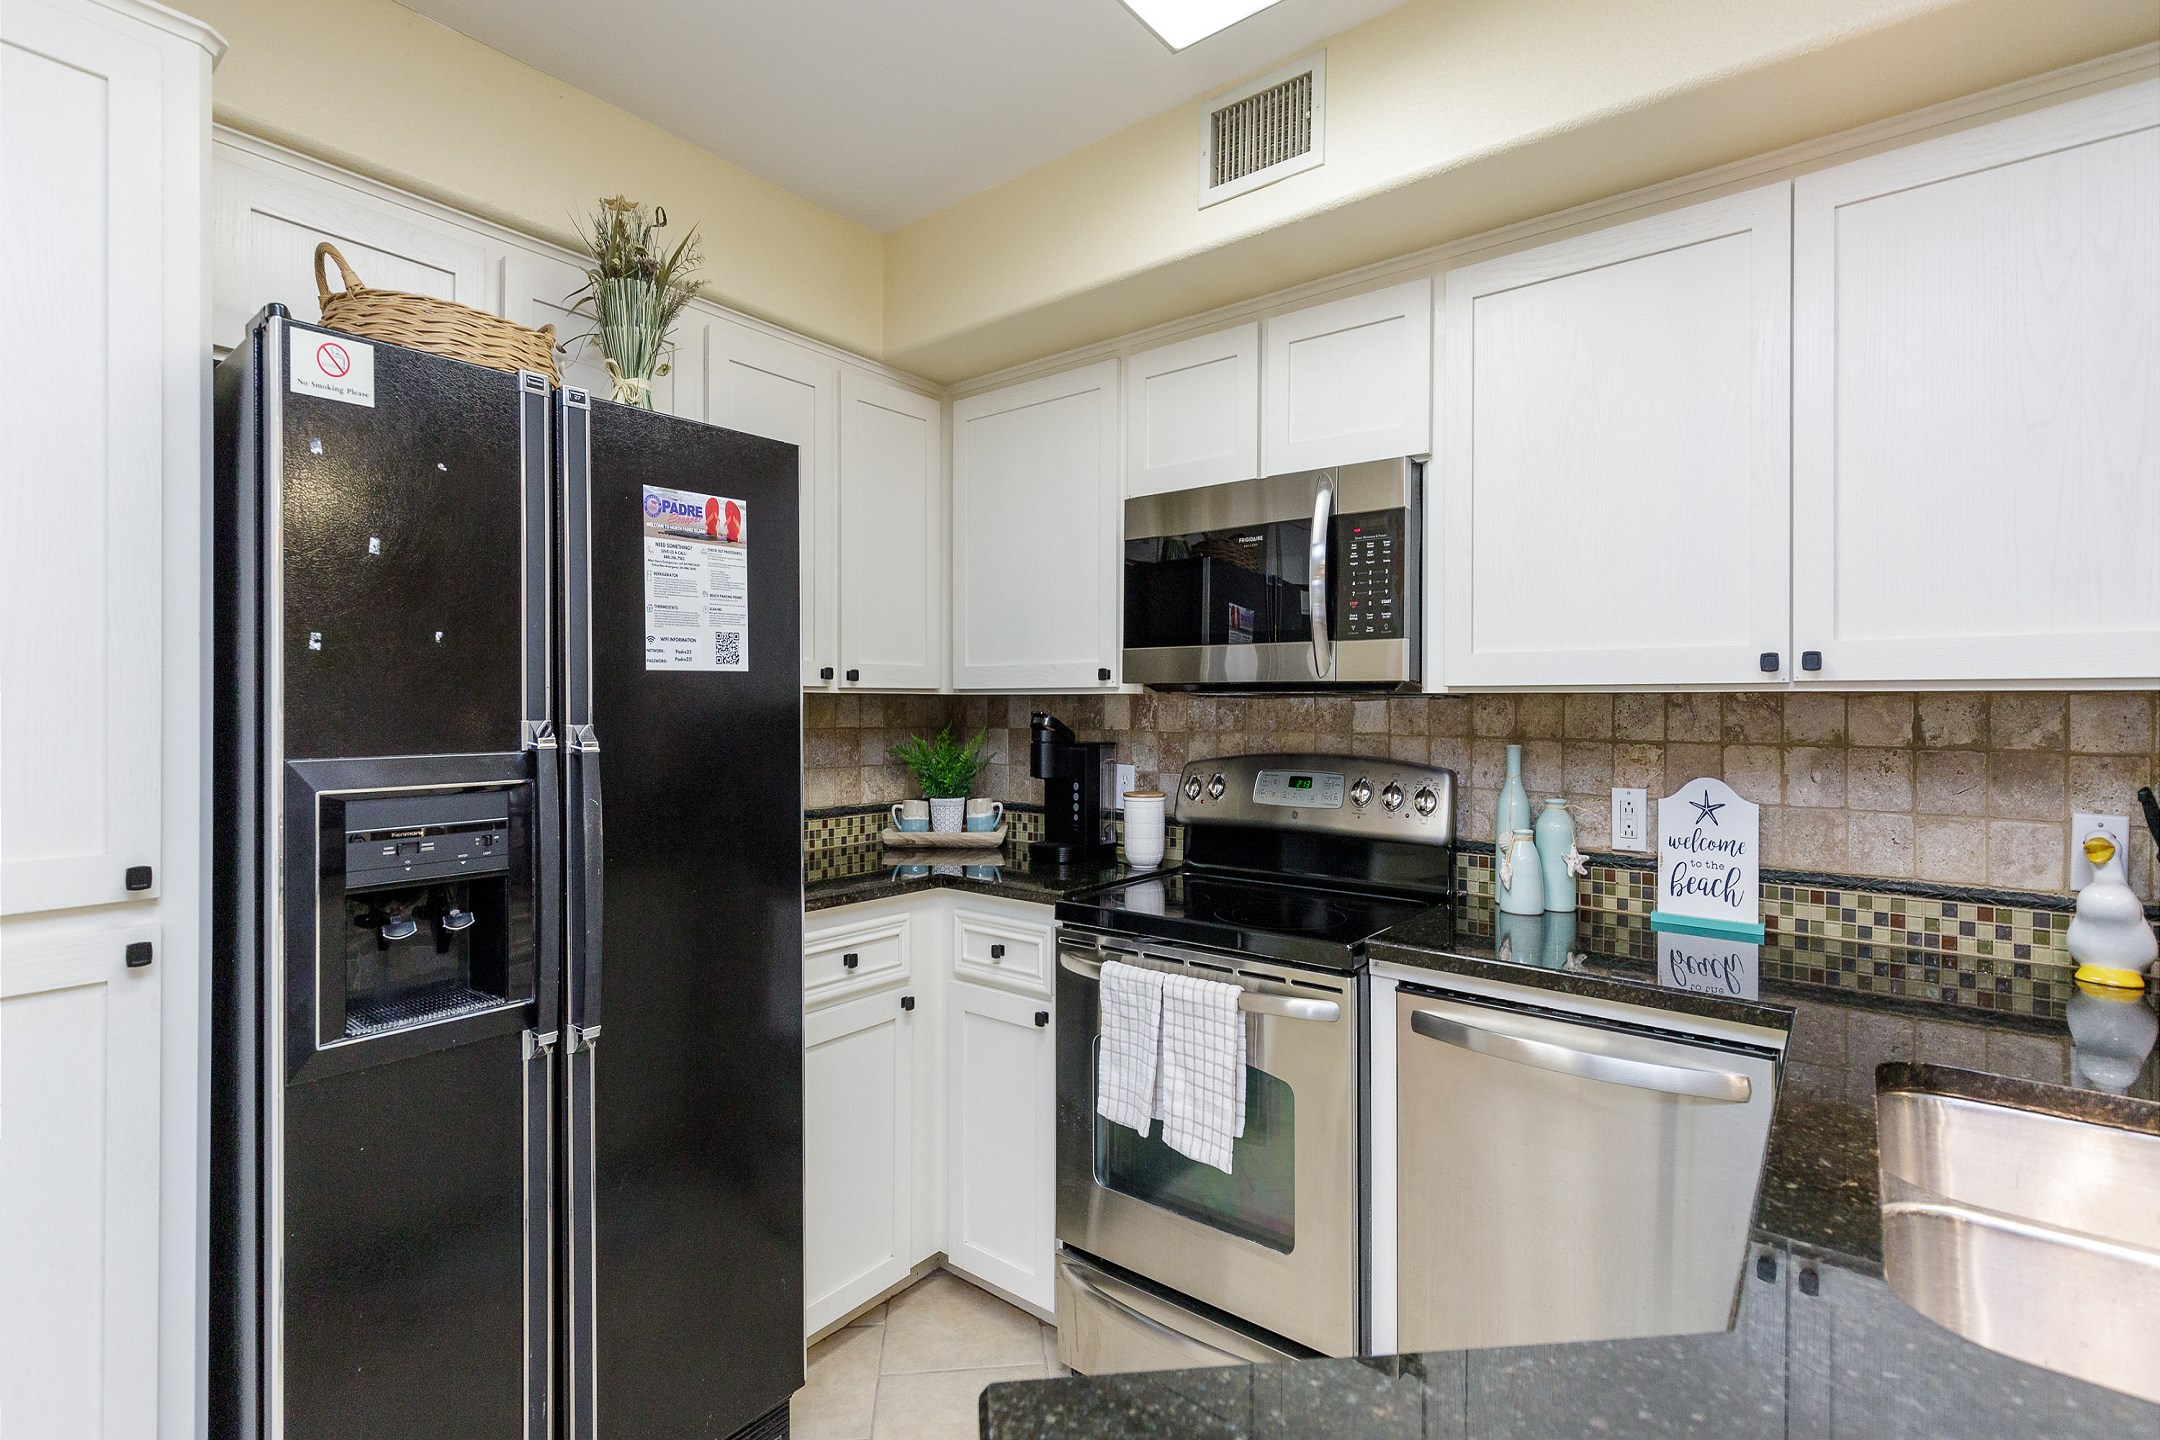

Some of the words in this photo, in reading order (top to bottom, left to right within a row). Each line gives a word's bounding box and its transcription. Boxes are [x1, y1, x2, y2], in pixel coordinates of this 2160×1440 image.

[297, 378, 308, 386] No
[311, 381, 344, 395] Smoking
[346, 388, 370, 398] Please
[662, 500, 703, 518] PADRE
[1238, 535, 1263, 543] FRIGIDAIRE
[1668, 828, 1748, 858] welcome
[1690, 859, 1702, 868] to
[1706, 860, 1725, 871] the
[1670, 861, 1744, 908] beach
